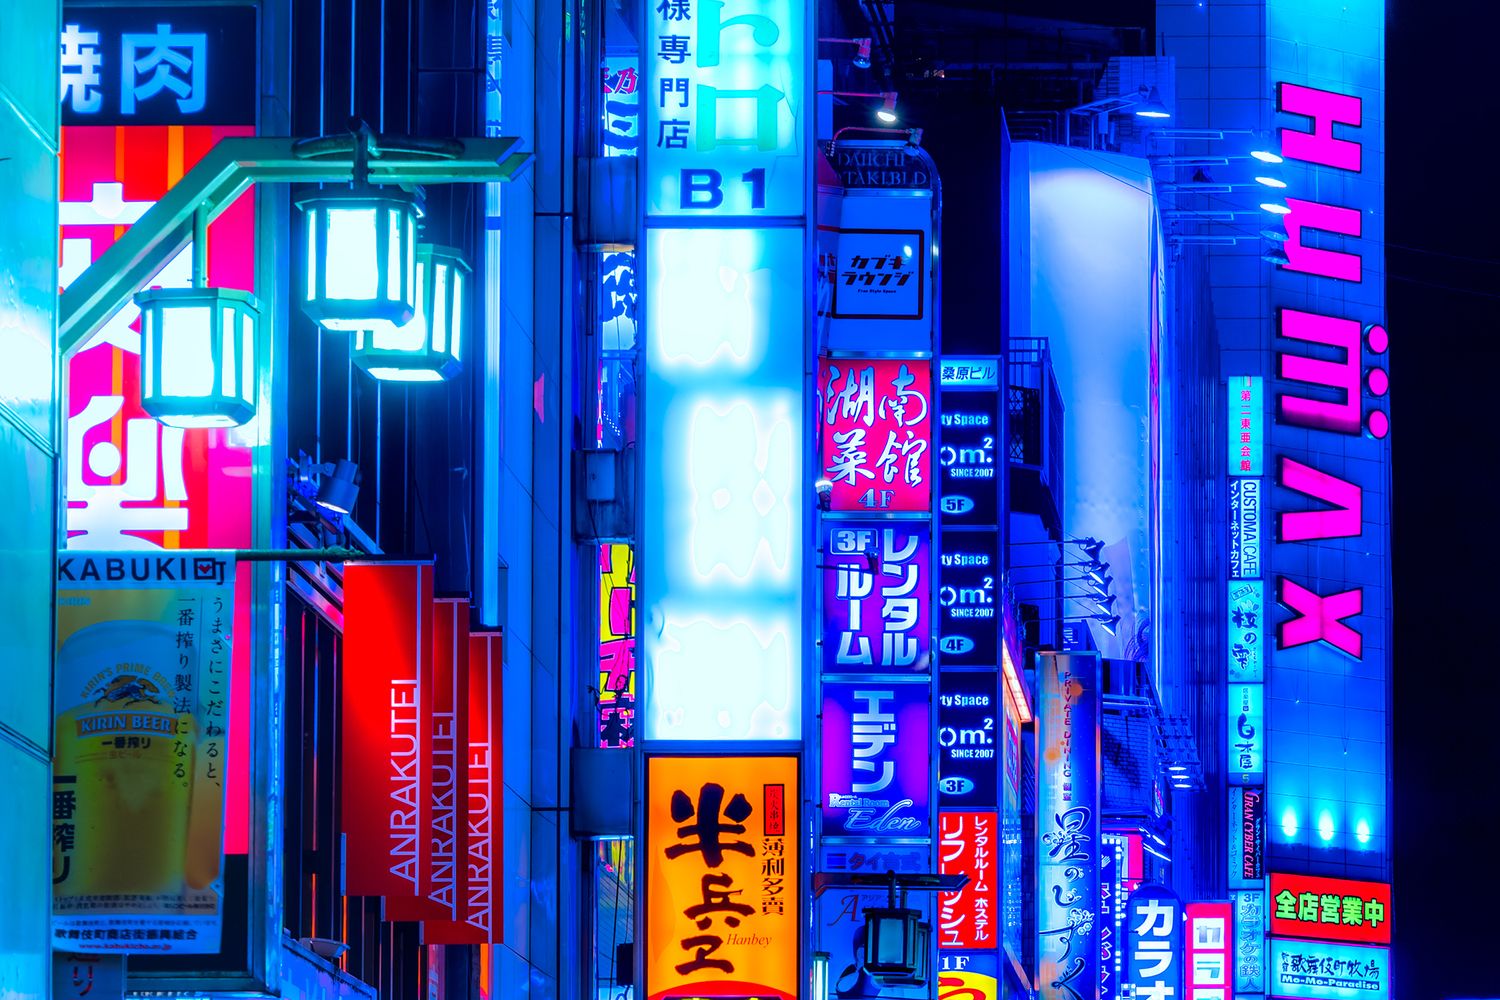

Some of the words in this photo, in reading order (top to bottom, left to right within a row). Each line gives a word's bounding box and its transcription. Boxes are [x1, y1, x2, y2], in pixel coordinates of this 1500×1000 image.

[841, 271, 914, 287] ラウンジ
[941, 365, 996, 382] 桑原ビル
[827, 361, 929, 428] 湖南
[954, 413, 989, 428] Space
[1240, 389, 1251, 471] 第二東亜会館
[827, 429, 928, 487] 菜館
[951, 468, 973, 479] SINCE
[973, 468, 994, 479] 2007
[858, 488, 895, 509] 4F
[945, 497, 966, 513] 5F
[837, 530, 873, 552] 3F
[954, 552, 989, 567] Space
[881, 528, 919, 667] レンタル
[836, 563, 874, 666] ルーム
[951, 608, 973, 618] SINCE
[973, 608, 994, 618] 2007
[945, 637, 966, 652] 4F
[173, 598, 196, 788] 一番搾り製法になる。
[206, 597, 224, 788] うまさにこだわると、
[954, 693, 989, 708] Space
[1063, 671, 1072, 726] PRIVATE
[81, 716, 127, 732] KIRIN
[132, 716, 171, 731] BEER
[101, 736, 151, 749] 一番搾り
[850, 689, 895, 793] エデン
[951, 749, 973, 759] SINCE
[973, 749, 994, 759] 2007
[1063, 730, 1072, 778] DINING
[390, 680, 418, 883] ANRAKUTEI
[945, 778, 966, 794] 3F
[427, 711, 455, 908] ANRAKUTEI
[828, 793, 863, 808] Rental
[843, 799, 922, 832] Eden
[465, 742, 491, 932] ANRAKUTEI
[1243, 821, 1255, 854] CYBER
[973, 815, 990, 892] レンタルルーム
[1243, 855, 1255, 878] CAFE
[1243, 893, 1261, 903] 3F
[1275, 889, 1385, 928] 全店営業中
[973, 897, 989, 942] ホステル
[726, 932, 773, 948] Hanbey
[1239, 903, 1261, 990] カラオケの鉄人
[941, 956, 970, 970] 1F
[1280, 973, 1380, 991] Mo-Mo-Paradise
